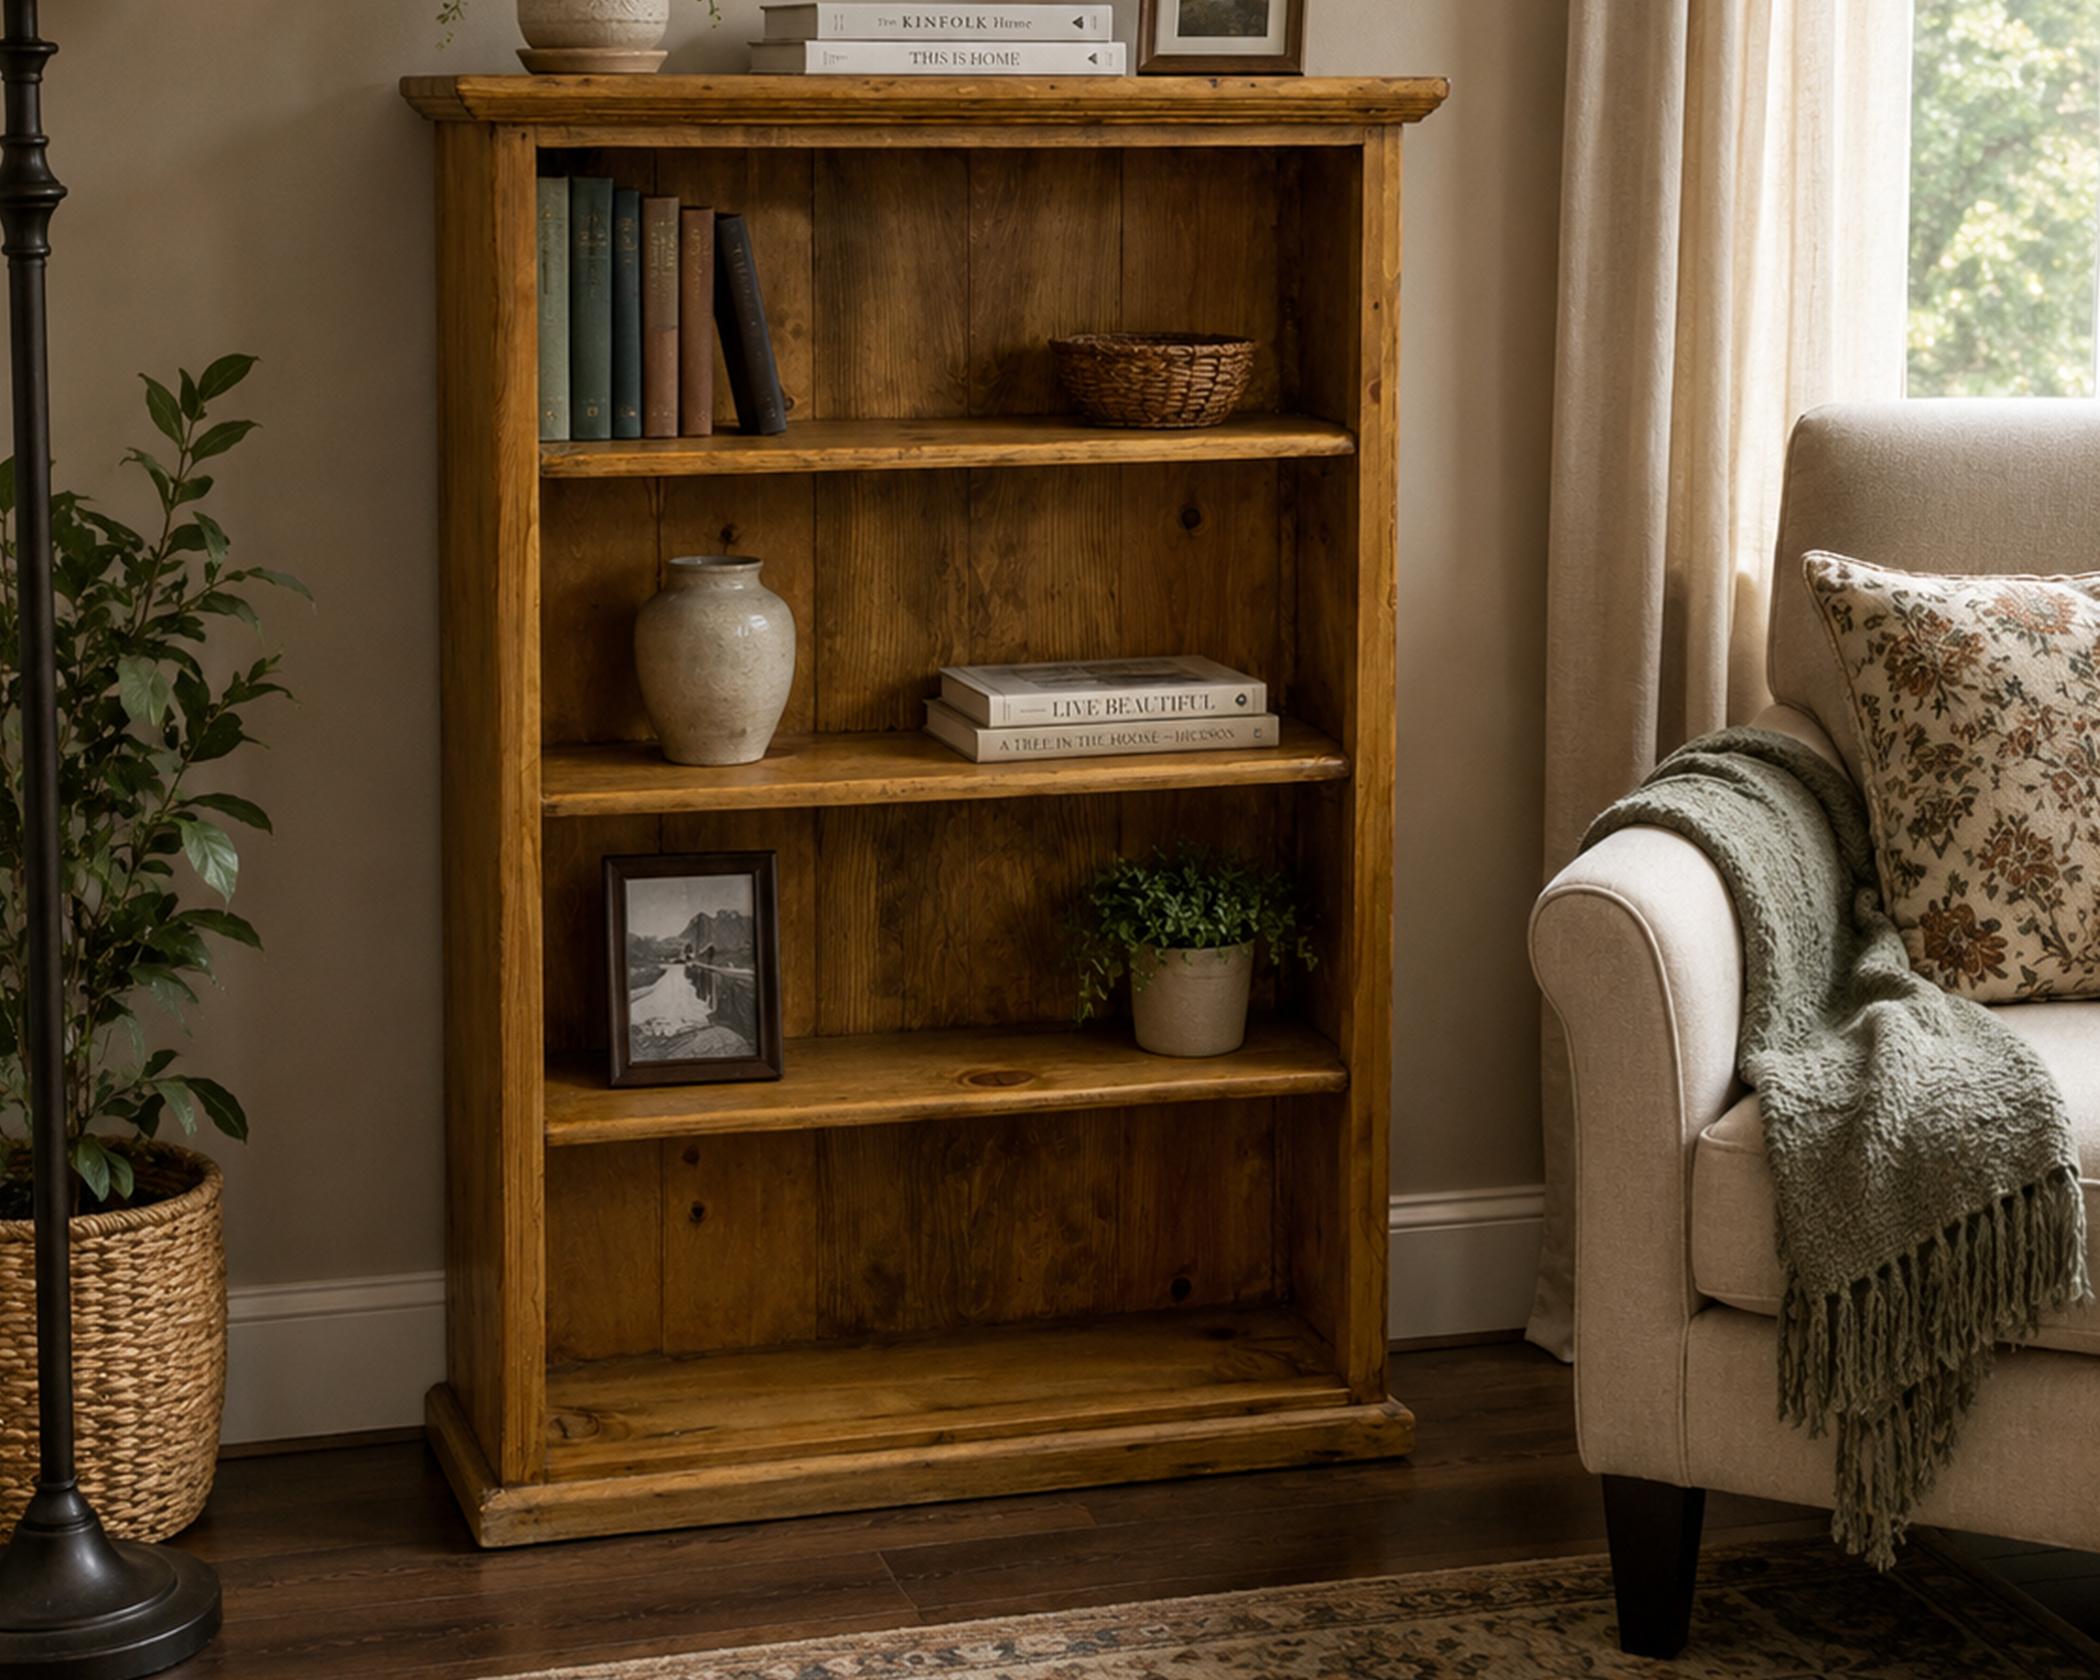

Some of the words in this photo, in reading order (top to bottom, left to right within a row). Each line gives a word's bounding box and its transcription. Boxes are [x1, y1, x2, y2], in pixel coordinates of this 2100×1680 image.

[902, 15, 987, 29] KINFOLK
[909, 51, 948, 65] THIS
[952, 51, 967, 65] IS
[970, 51, 1021, 66] HOME
[1053, 698, 1102, 718] LIVE
[1105, 693, 1217, 715] BEAUTIFUL
[999, 739, 1010, 751] A
[1055, 736, 1073, 749] IN
